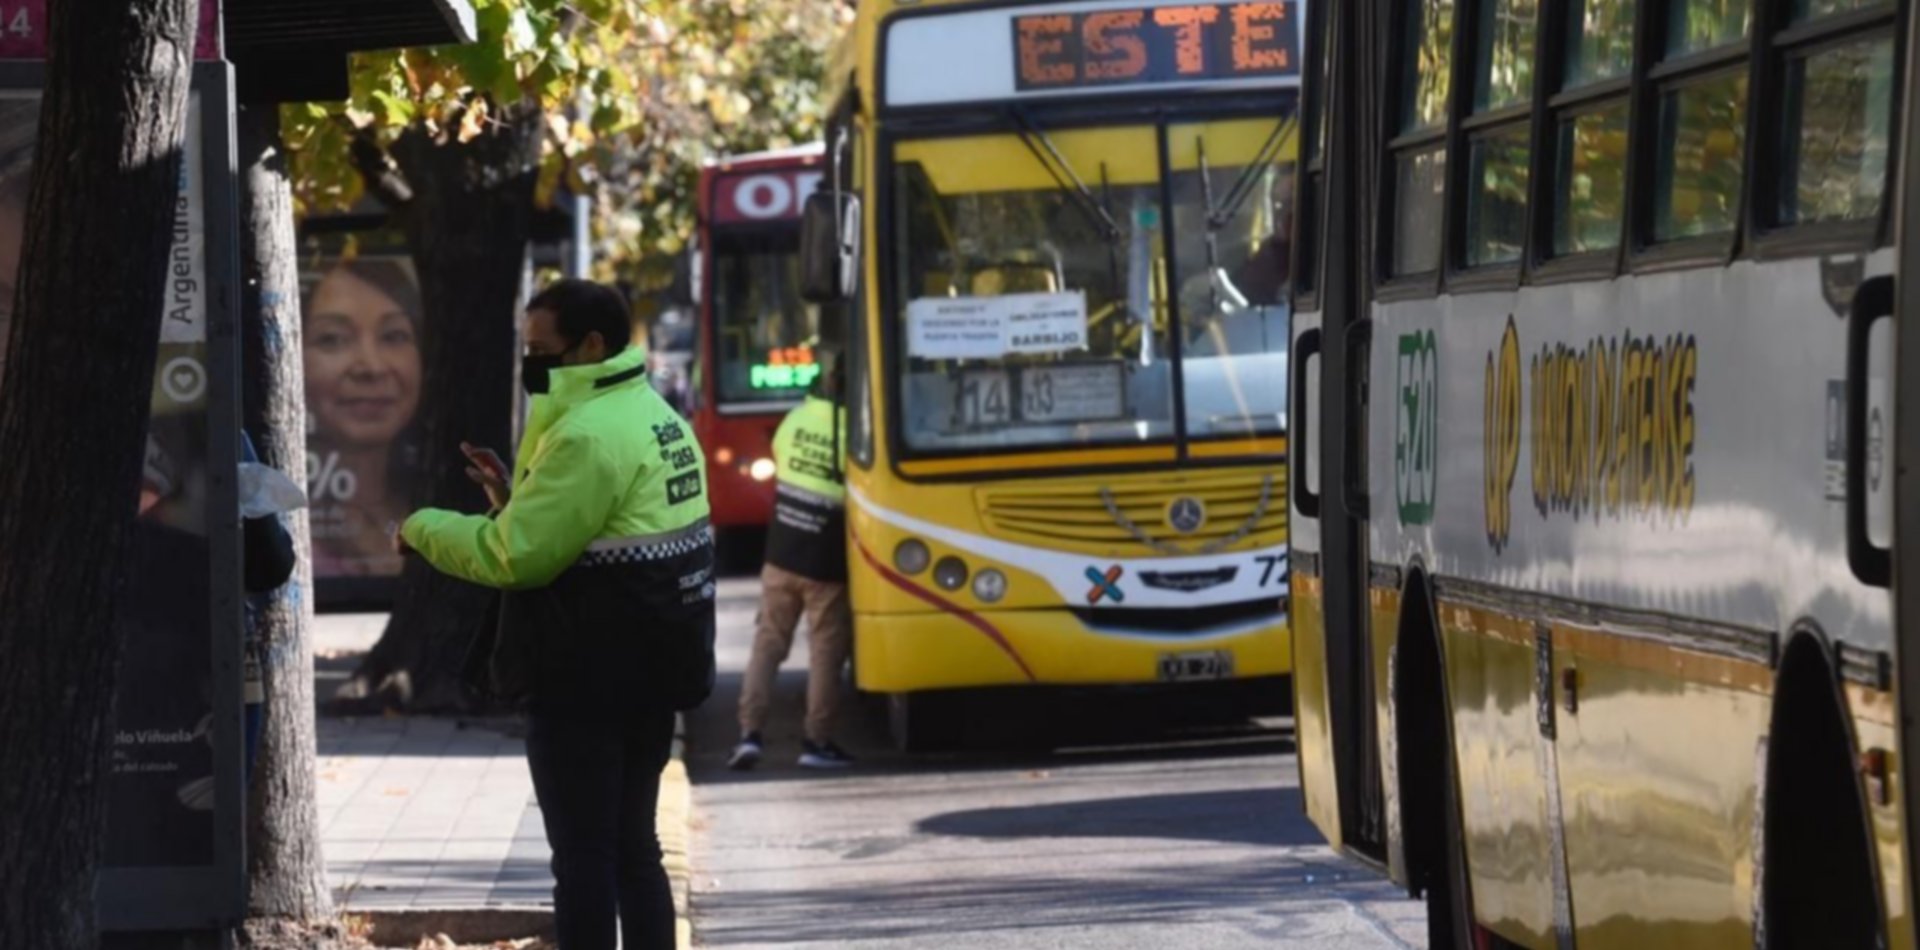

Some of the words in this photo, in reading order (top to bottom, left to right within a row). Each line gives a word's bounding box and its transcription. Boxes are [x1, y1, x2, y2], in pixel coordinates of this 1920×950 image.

[1017, 1, 1289, 83] ESTE
[1011, 331, 1080, 347] BARBIJO
[964, 379, 1006, 424] 14
[1395, 327, 1438, 528] 520
[1483, 312, 1522, 557] UP
[135, 729, 193, 744] Viñuela
